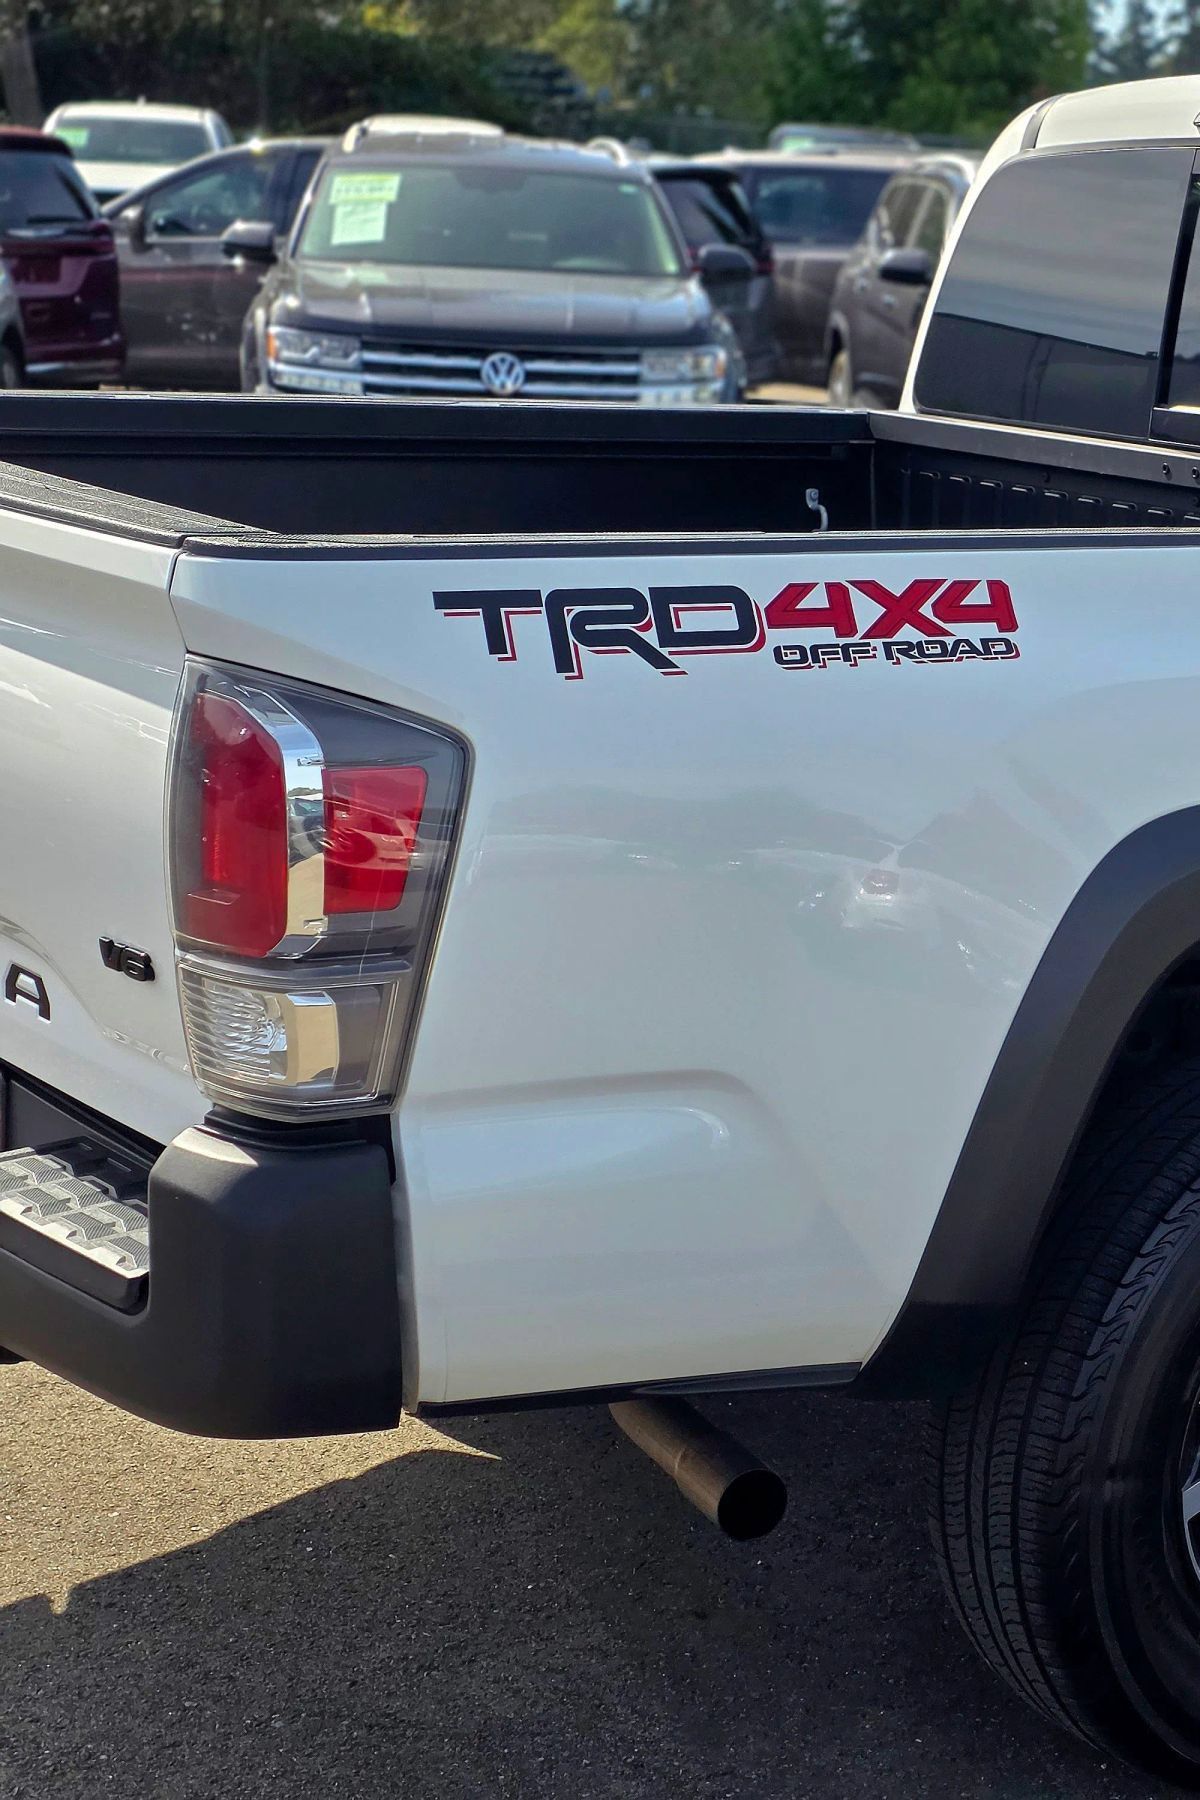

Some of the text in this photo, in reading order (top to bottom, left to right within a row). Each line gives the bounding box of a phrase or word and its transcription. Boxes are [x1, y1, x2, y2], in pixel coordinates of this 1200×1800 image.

[431, 584, 767, 682] TRD
[772, 635, 1021, 671] OFF ROAD
[98, 935, 156, 983] V6
